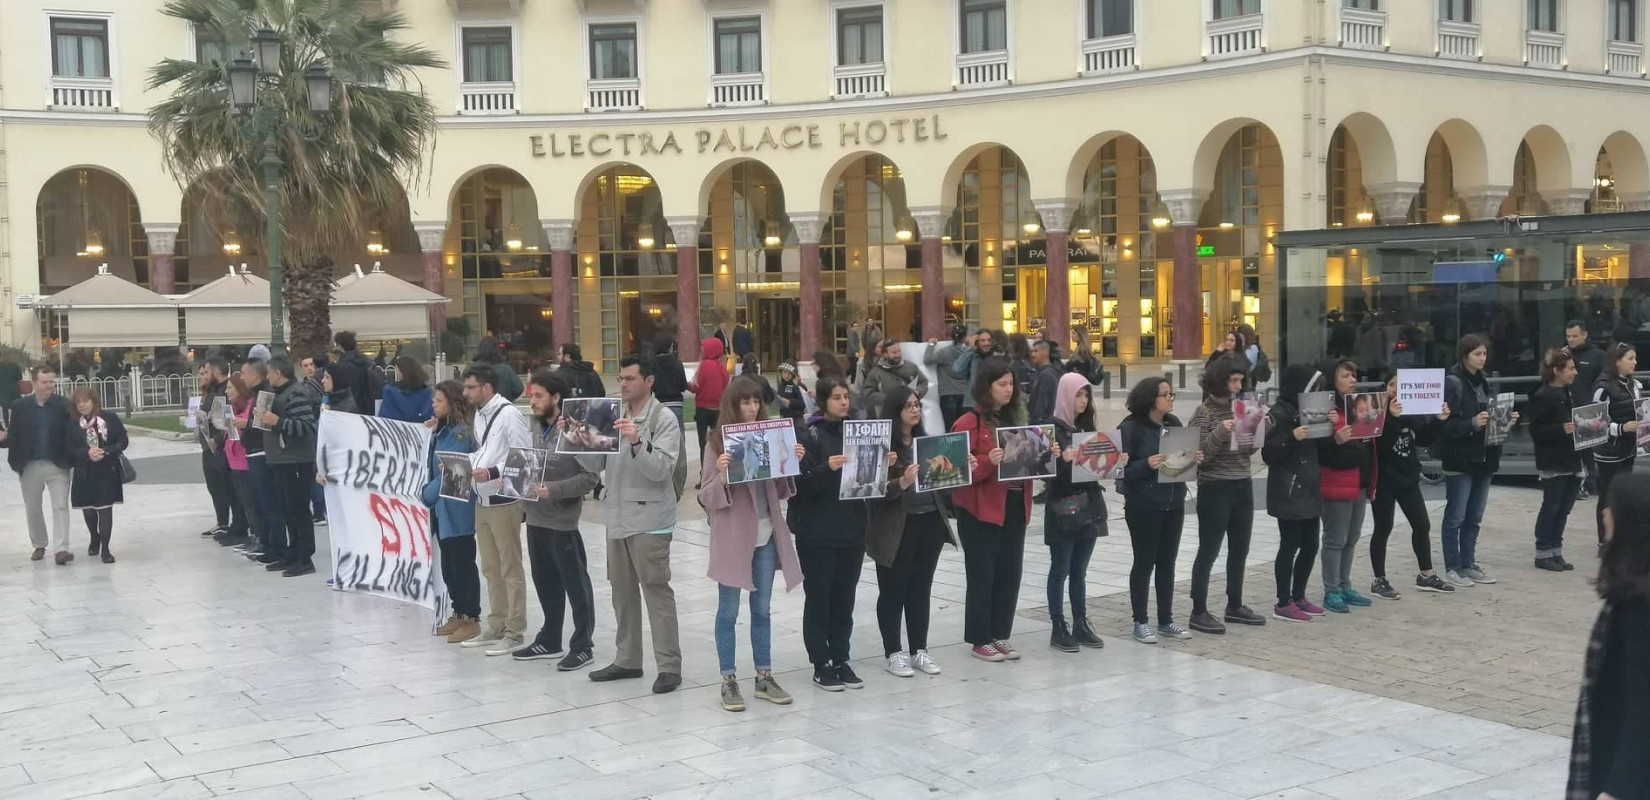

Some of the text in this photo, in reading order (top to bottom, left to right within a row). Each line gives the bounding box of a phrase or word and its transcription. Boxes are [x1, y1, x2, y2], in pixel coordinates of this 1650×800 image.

[530, 114, 948, 158] ELECTRA PALACE HOTEL
[1401, 382, 1413, 390] IT'S
[1414, 382, 1425, 390] NOT
[1414, 392, 1440, 400] VIOLENCE
[845, 422, 890, 437] Η ΣΦΑΓΗ
[322, 443, 426, 499] LIBERATI
[336, 548, 421, 601] KILLING
